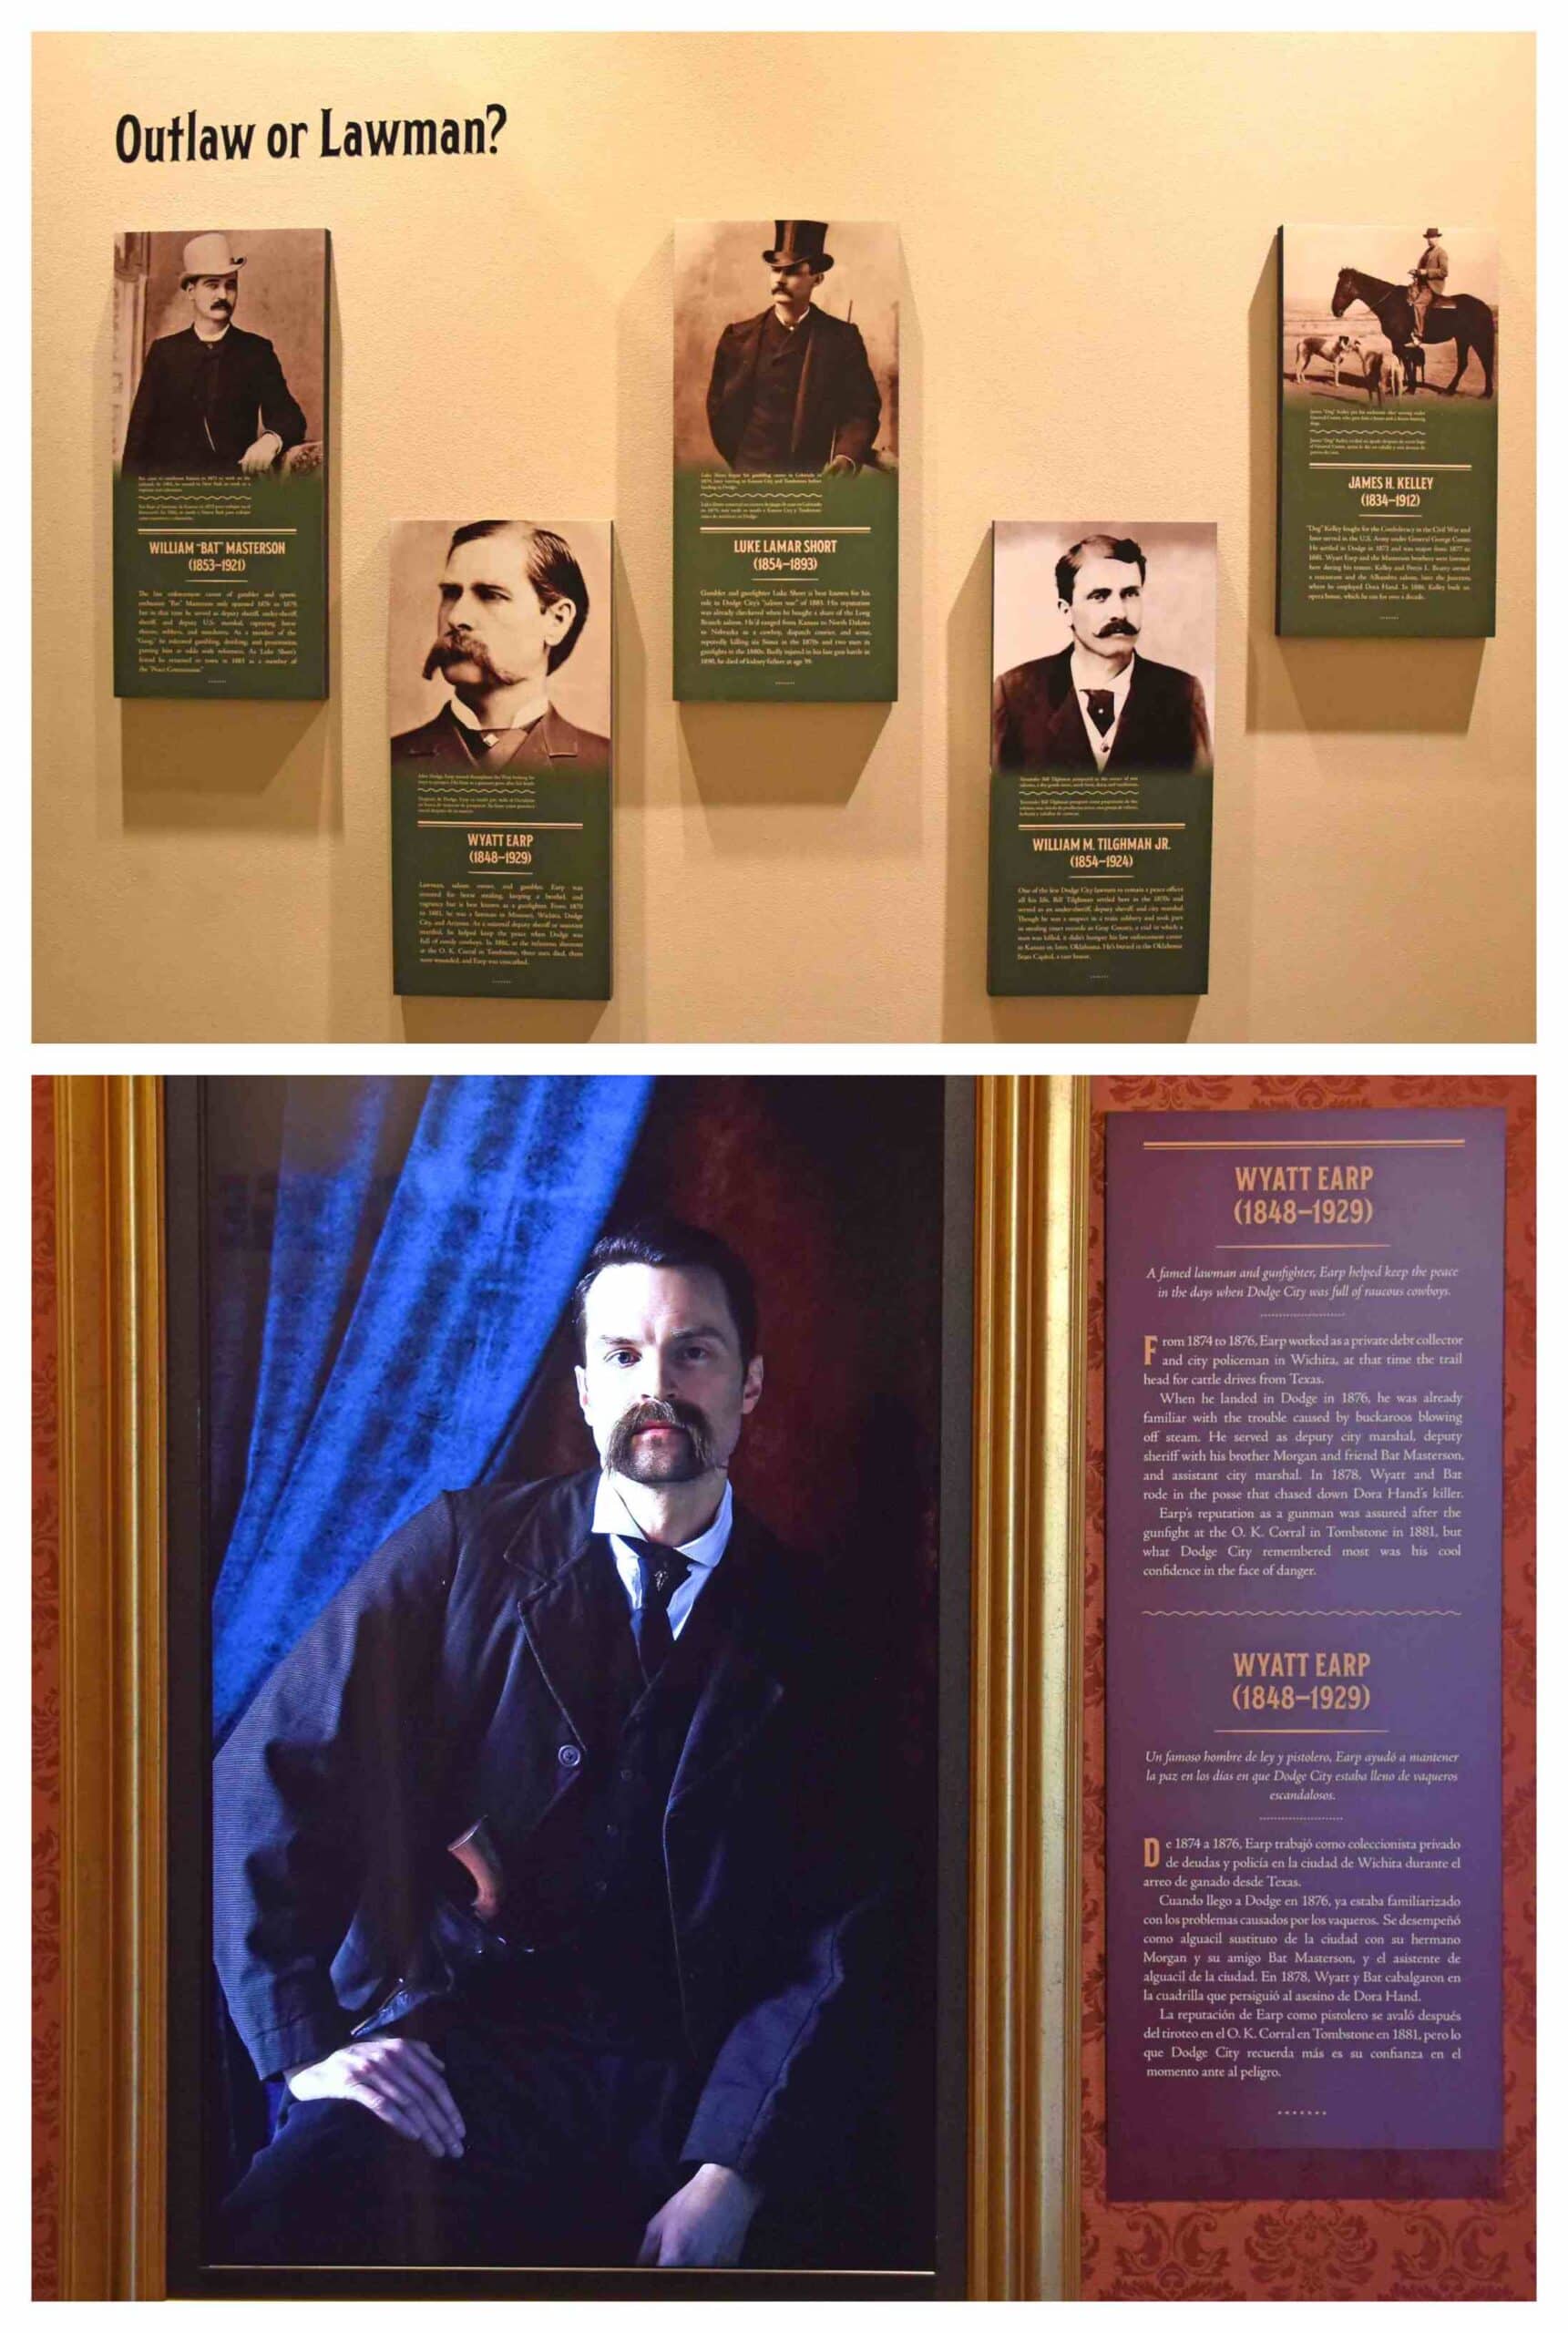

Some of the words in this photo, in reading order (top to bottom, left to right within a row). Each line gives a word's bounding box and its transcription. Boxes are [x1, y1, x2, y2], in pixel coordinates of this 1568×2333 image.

[116, 109, 256, 163] Outlaw
[267, 122, 308, 159] or
[320, 103, 507, 158] Lawman?
[1348, 476, 1383, 489] JAMES
[1385, 477, 1395, 489] H.
[1398, 477, 1434, 490] KELLEY
[1361, 493, 1420, 508] (1834–1912)
[149, 541, 194, 554] WILLIAM
[197, 541, 223, 554] "BAT"
[226, 541, 285, 554] MASTERSON
[734, 540, 761, 553] LUKE
[764, 540, 802, 553] LAMAR
[804, 540, 837, 553] SHORT
[189, 558, 246, 572] (1853–1921)
[753, 557, 817, 570] (1854–1893)
[467, 833, 504, 846] WYATT
[507, 834, 534, 847] EARP
[1032, 838, 1081, 851] WILLIAM
[1083, 838, 1095, 850] M.
[1097, 838, 1152, 850] TILGHMAN
[1154, 837, 1172, 850] JR.
[469, 850, 532, 864] (1848–1929)
[1070, 855, 1133, 868] (1854–1924)
[1235, 1166, 1312, 1191] WYATT
[1317, 1166, 1374, 1191] EARP
[1234, 1197, 1374, 1225] (1848–1929)
[1158, 1286, 1168, 1297] in
[1172, 1286, 1187, 1297] the
[1190, 1286, 1213, 1300] days
[1216, 1286, 1244, 1297] when
[1247, 1285, 1281, 1300] Dodge
[1283, 1286, 1307, 1300] City
[1309, 1289, 1328, 1297] was
[1330, 1285, 1348, 1300] full
[1351, 1286, 1363, 1300] of
[1365, 1288, 1403, 1296] raucous
[1407, 1285, 1450, 1299] cowboys.
[1162, 1354, 1184, 1365] and
[1187, 1354, 1208, 1369] city
[1213, 1354, 1269, 1369] policeman
[1275, 1354, 1286, 1365] in
[1290, 1353, 1339, 1367] Wichita,
[1343, 1354, 1354, 1365] at
[1359, 1353, 1382, 1364] that
[1387, 1354, 1412, 1364] time
[1416, 1352, 1434, 1364] the
[1440, 1352, 1462, 1364] trail
[1143, 1373, 1170, 1385] head
[1173, 1373, 1188, 1385] for
[1191, 1373, 1221, 1385] cattle
[1224, 1373, 1256, 1384] drives
[1259, 1372, 1286, 1384] from
[1289, 1372, 1324, 1384] Texas.
[1143, 1431, 1160, 1442] off
[1166, 1431, 1201, 1442] steam.
[1209, 1431, 1226, 1442] He
[1234, 1430, 1268, 1442] served
[1276, 1434, 1288, 1442] as
[1295, 1431, 1334, 1445] deputy
[1341, 1431, 1361, 1444] city
[1369, 1430, 1416, 1444] marshal,
[1423, 1430, 1462, 1444] deputy
[1143, 1469, 1164, 1480] and
[1172, 1469, 1219, 1480] assistant
[1225, 1469, 1247, 1484] city
[1255, 1468, 1302, 1480] marshal.
[1311, 1469, 1323, 1480] In
[1332, 1469, 1362, 1482] 1878,
[1370, 1468, 1407, 1484] Wyatt
[1414, 1468, 1435, 1480] and
[1443, 1468, 1462, 1479] Bat
[1143, 1564, 1201, 1576] confidence
[1204, 1565, 1214, 1576] in
[1218, 1564, 1235, 1576] the
[1239, 1564, 1259, 1576] face
[1263, 1564, 1275, 1576] of
[1276, 1564, 1316, 1579] danger.
[1233, 1652, 1309, 1678] WYATT
[1316, 1652, 1371, 1677] EARP
[1232, 1684, 1370, 1711] (1848–1929)
[1146, 1752, 1163, 1763] Un
[1165, 1750, 1201, 1764] famoso
[1204, 1751, 1242, 1763] hombre
[1245, 1751, 1257, 1762] de
[1260, 1751, 1275, 1765] ley
[1278, 1754, 1284, 1765] y
[1286, 1751, 1332, 1765] pistolero,
[1336, 1752, 1361, 1765] Earp
[1365, 1751, 1397, 1765] ayudó
[1399, 1754, 1406, 1763] a
[1409, 1752, 1459, 1763] mantener
[1143, 1935, 1173, 1944] como
[1180, 1932, 1223, 1948] alguacil
[1228, 1933, 1278, 1944] sustituto
[1284, 1932, 1297, 1944] de
[1305, 1933, 1314, 1944] la
[1320, 1933, 1358, 1944] ciudad
[1365, 1936, 1385, 1944] con
[1391, 1936, 1404, 1944] su
[1410, 1933, 1461, 1944] hermano
[1143, 1951, 1187, 1967] Morgan
[1194, 1955, 1201, 1967] y
[1207, 1955, 1221, 1963] su
[1227, 1952, 1261, 1967] amigo
[1268, 1952, 1287, 1963] Bat
[1295, 1952, 1356, 1965] Masterson,
[1363, 1955, 1370, 1967] y
[1376, 1952, 1386, 1963] el
[1392, 1952, 1440, 1963] asistente
[1447, 1952, 1461, 1963] de
[1160, 2009, 1173, 2020] La
[1177, 2009, 1235, 2023] reputación
[1239, 2009, 1253, 2020] de
[1256, 2009, 1284, 2024] Earp
[1286, 2011, 1317, 2020] como
[1321, 2009, 1368, 2024] pistolero
[1372, 2011, 1383, 2020] se
[1387, 2009, 1415, 2020] avaló
[1418, 2009, 1461, 2024] después
[1146, 2066, 1199, 2077] momento
[1201, 2066, 1225, 2077] ante
[1227, 2065, 1237, 2077] al
[1240, 2065, 1281, 2081] peligro.
